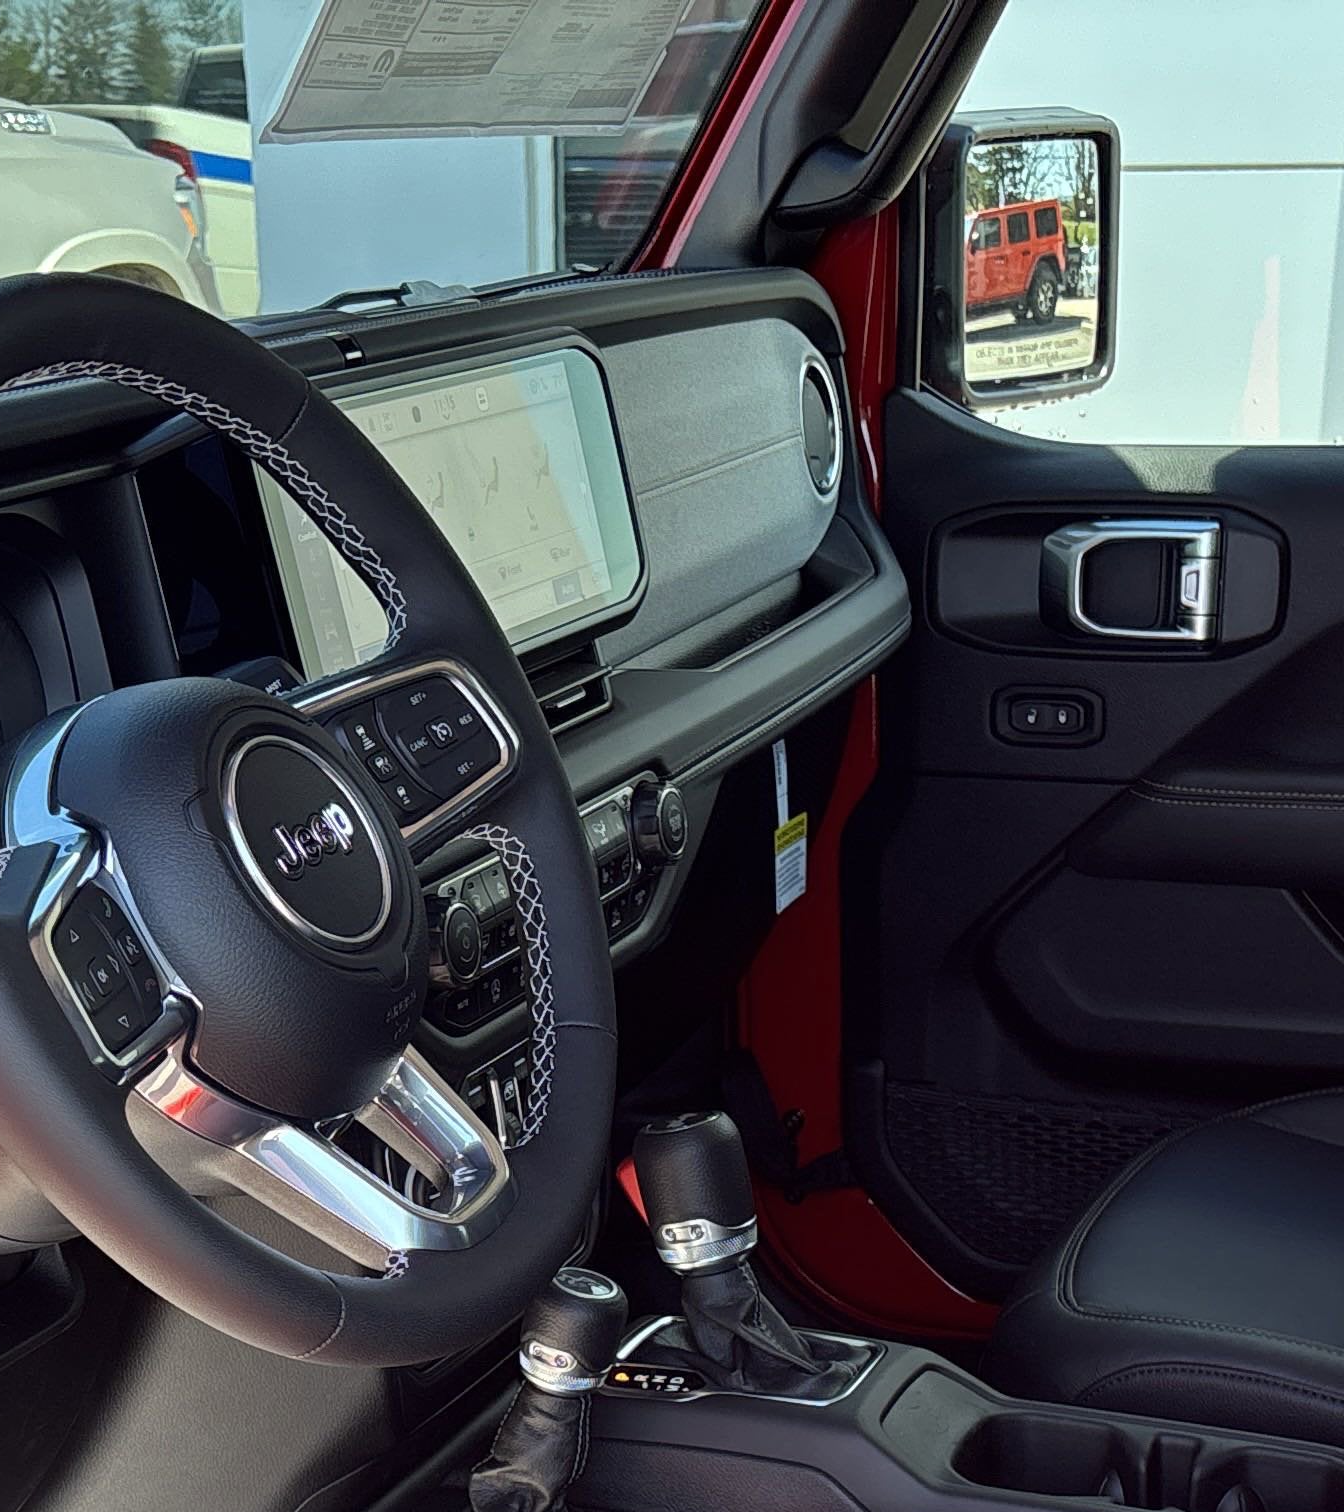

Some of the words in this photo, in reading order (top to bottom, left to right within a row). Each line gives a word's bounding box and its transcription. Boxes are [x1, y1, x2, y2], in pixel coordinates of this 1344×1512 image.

[458, 713, 474, 726] RES
[409, 736, 429, 752] CANC
[272, 801, 355, 881] Jeep
